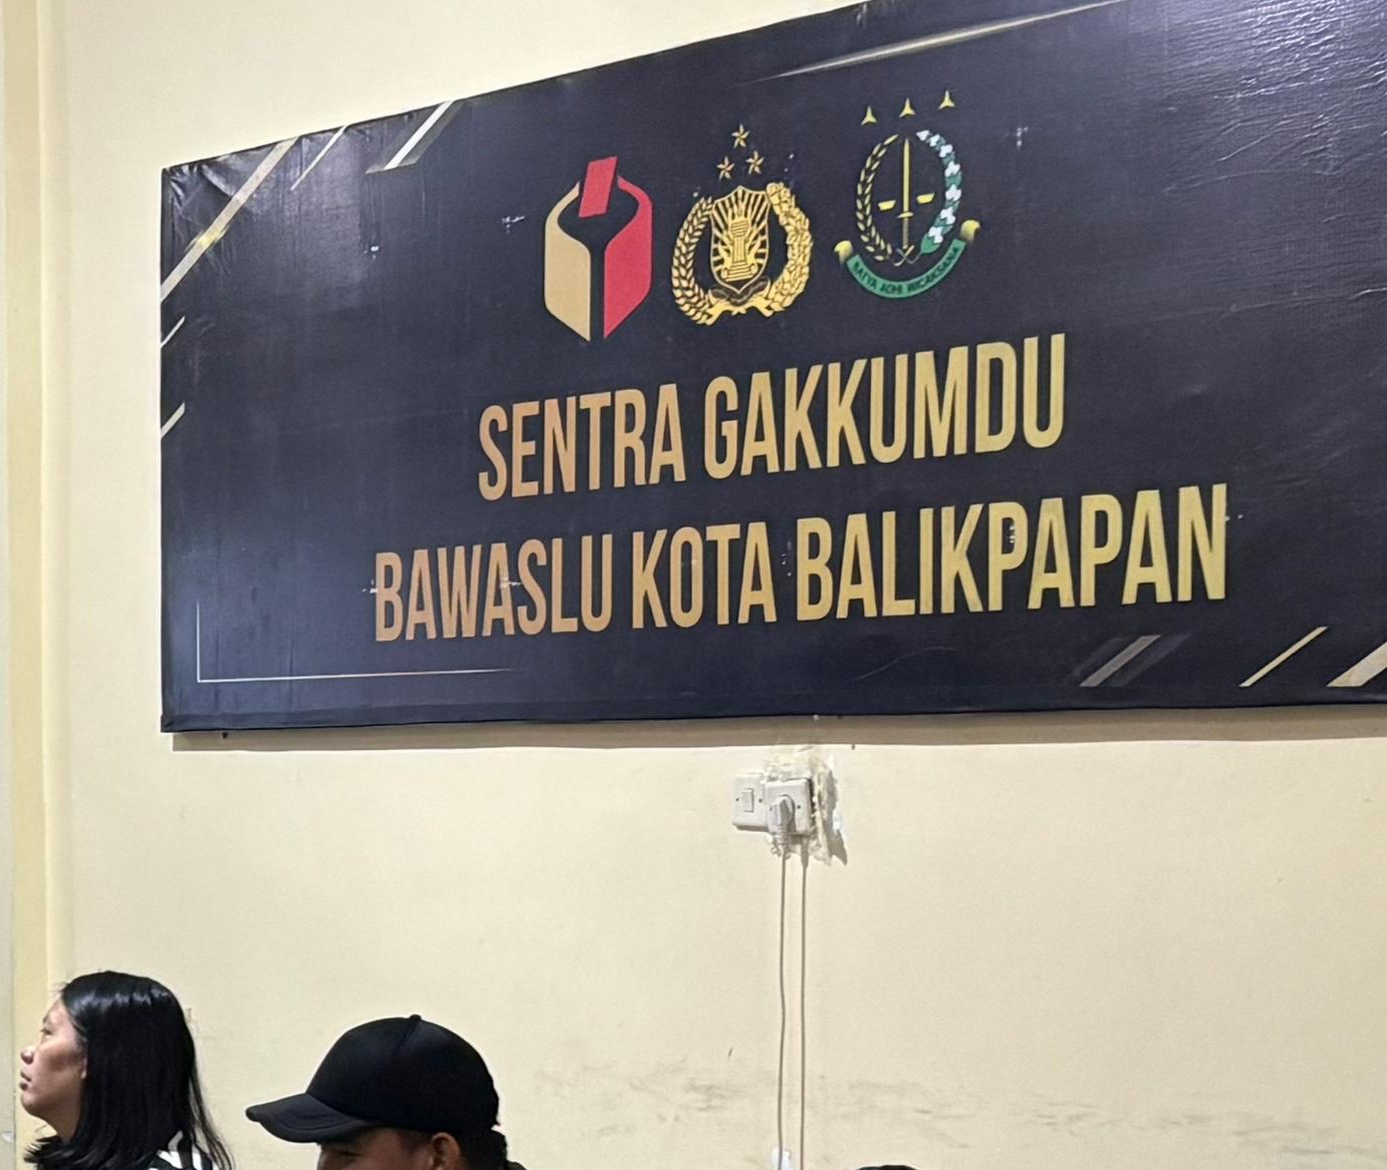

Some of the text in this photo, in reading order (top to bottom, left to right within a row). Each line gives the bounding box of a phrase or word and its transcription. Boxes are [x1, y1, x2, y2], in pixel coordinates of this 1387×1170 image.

[479, 334, 1066, 501] SENTRA GAKKUMDU
[374, 484, 1228, 643] BAWASLU KOTA BALIKPAPAN
